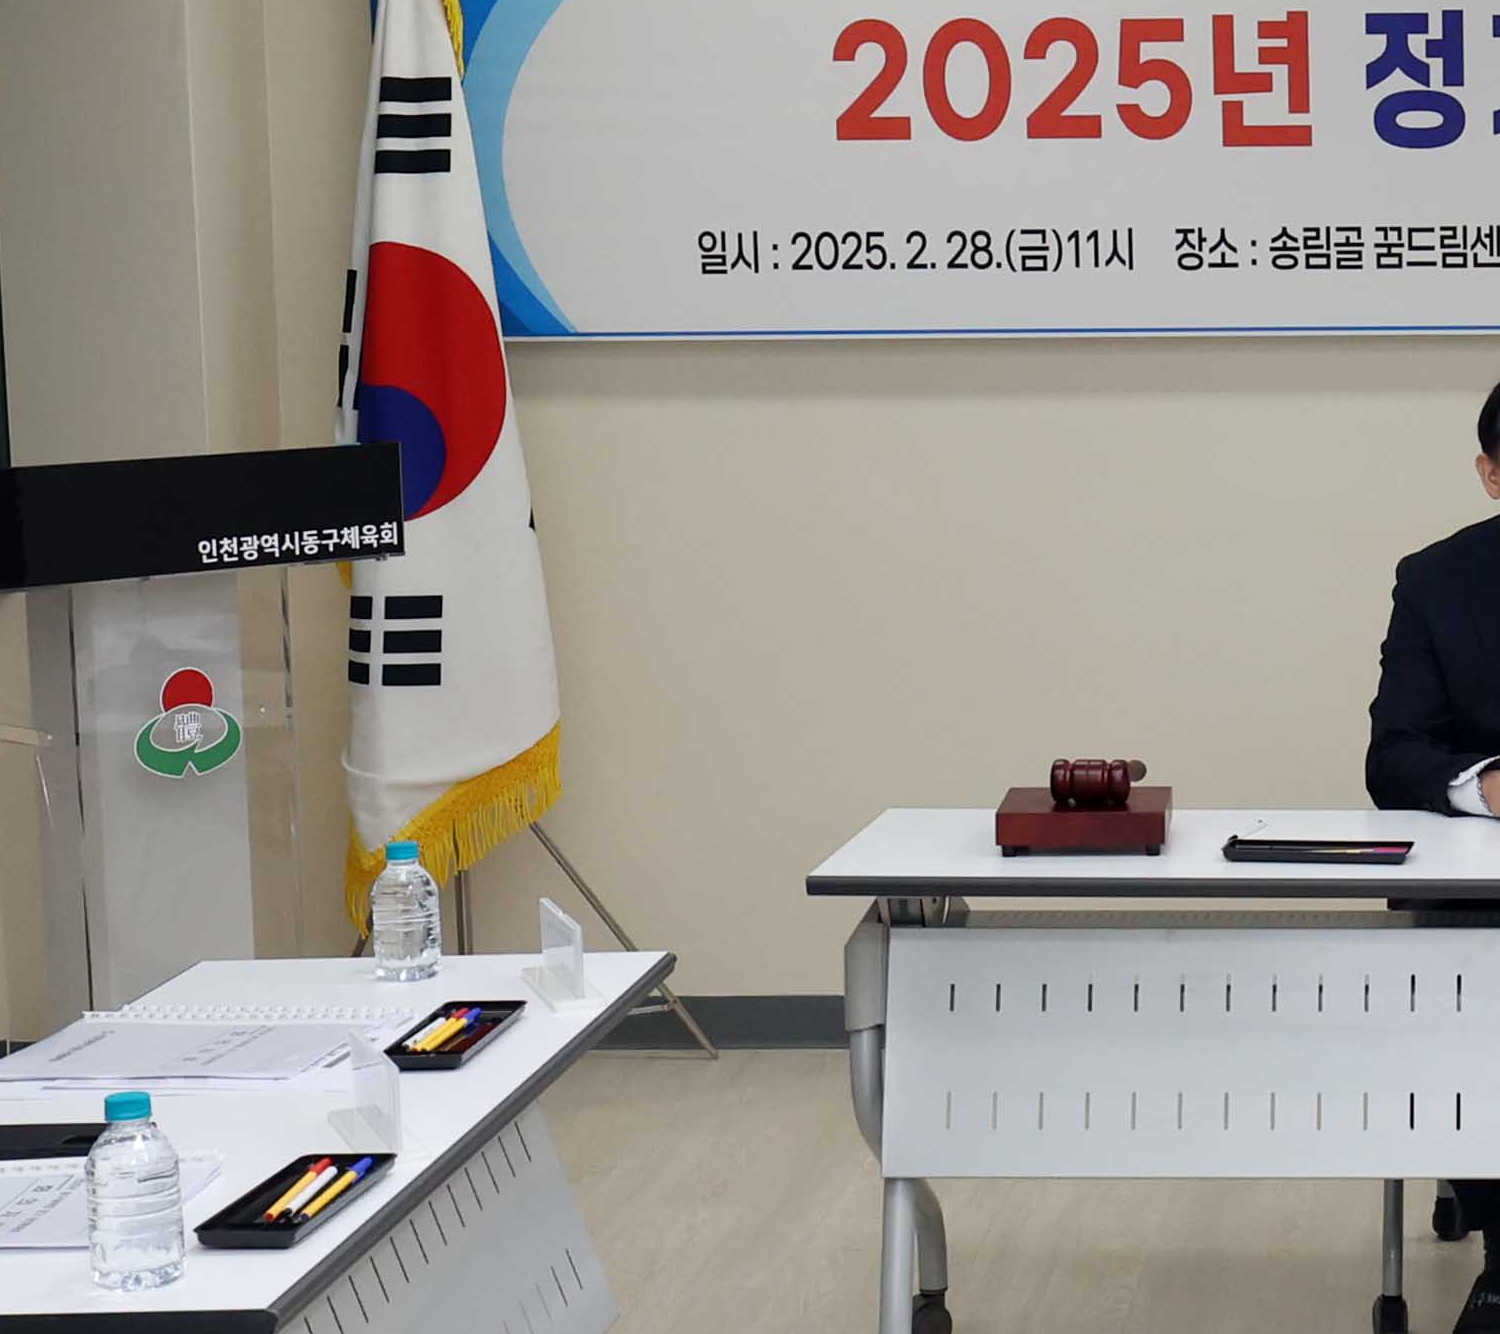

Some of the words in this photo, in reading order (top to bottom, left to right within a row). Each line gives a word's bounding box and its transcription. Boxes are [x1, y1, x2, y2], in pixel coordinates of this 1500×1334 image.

[832, 10, 1313, 148] 2025년
[696, 230, 760, 275] 일시
[789, 229, 897, 272] 2025.
[905, 229, 937, 271] 2.
[945, 226, 1135, 274] 28.(금)11시
[1174, 225, 1239, 272] 장소
[1268, 225, 1365, 274] 송림골
[197, 521, 398, 564] 인천광역시동구체육회
